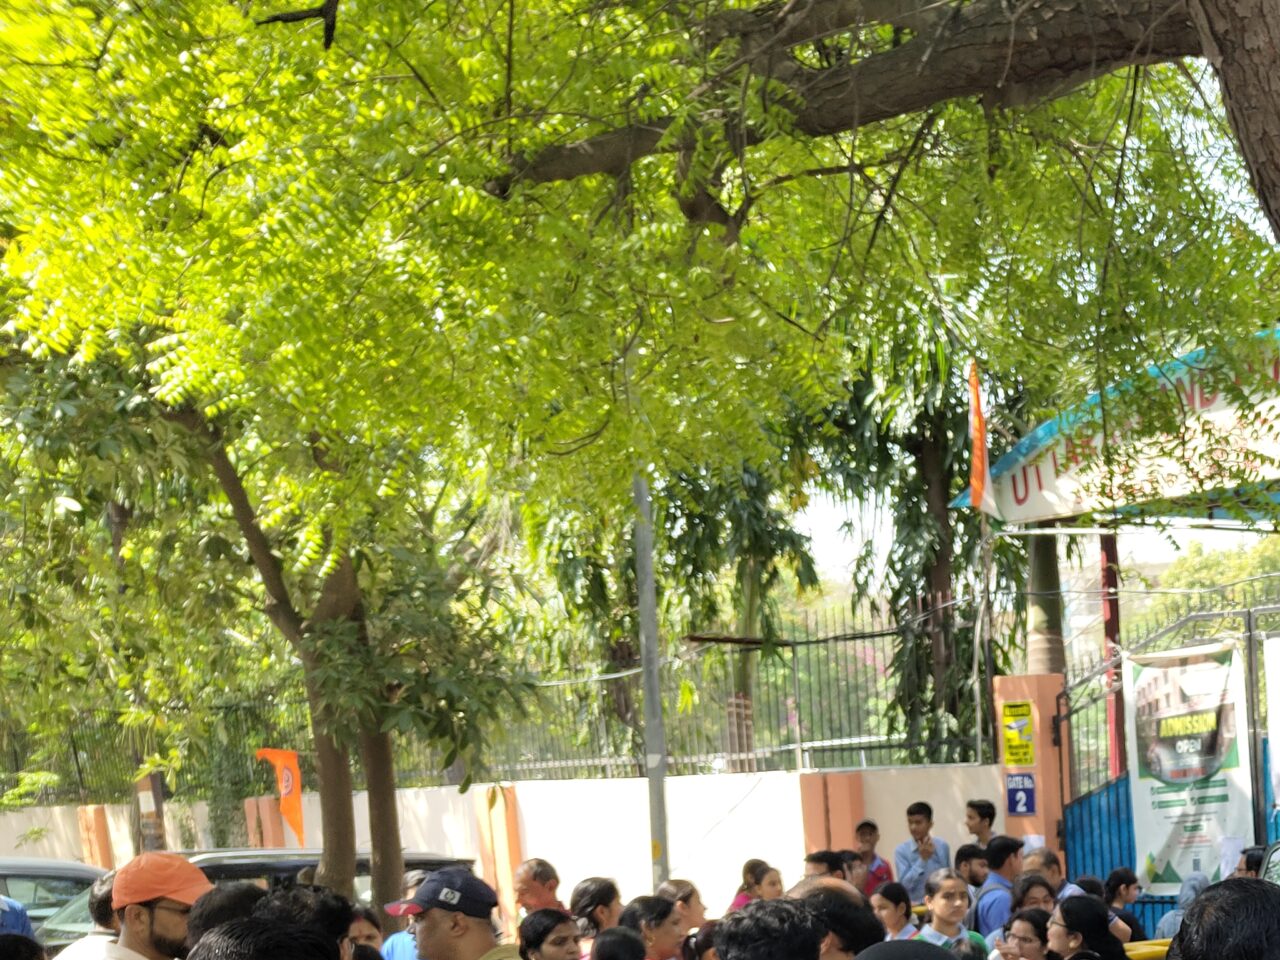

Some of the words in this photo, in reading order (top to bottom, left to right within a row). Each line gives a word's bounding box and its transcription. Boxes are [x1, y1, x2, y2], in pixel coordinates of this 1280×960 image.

[1159, 711, 1217, 738] ADMISSION
[1175, 738, 1202, 754] OPEN
[1015, 790, 1027, 812] 2
